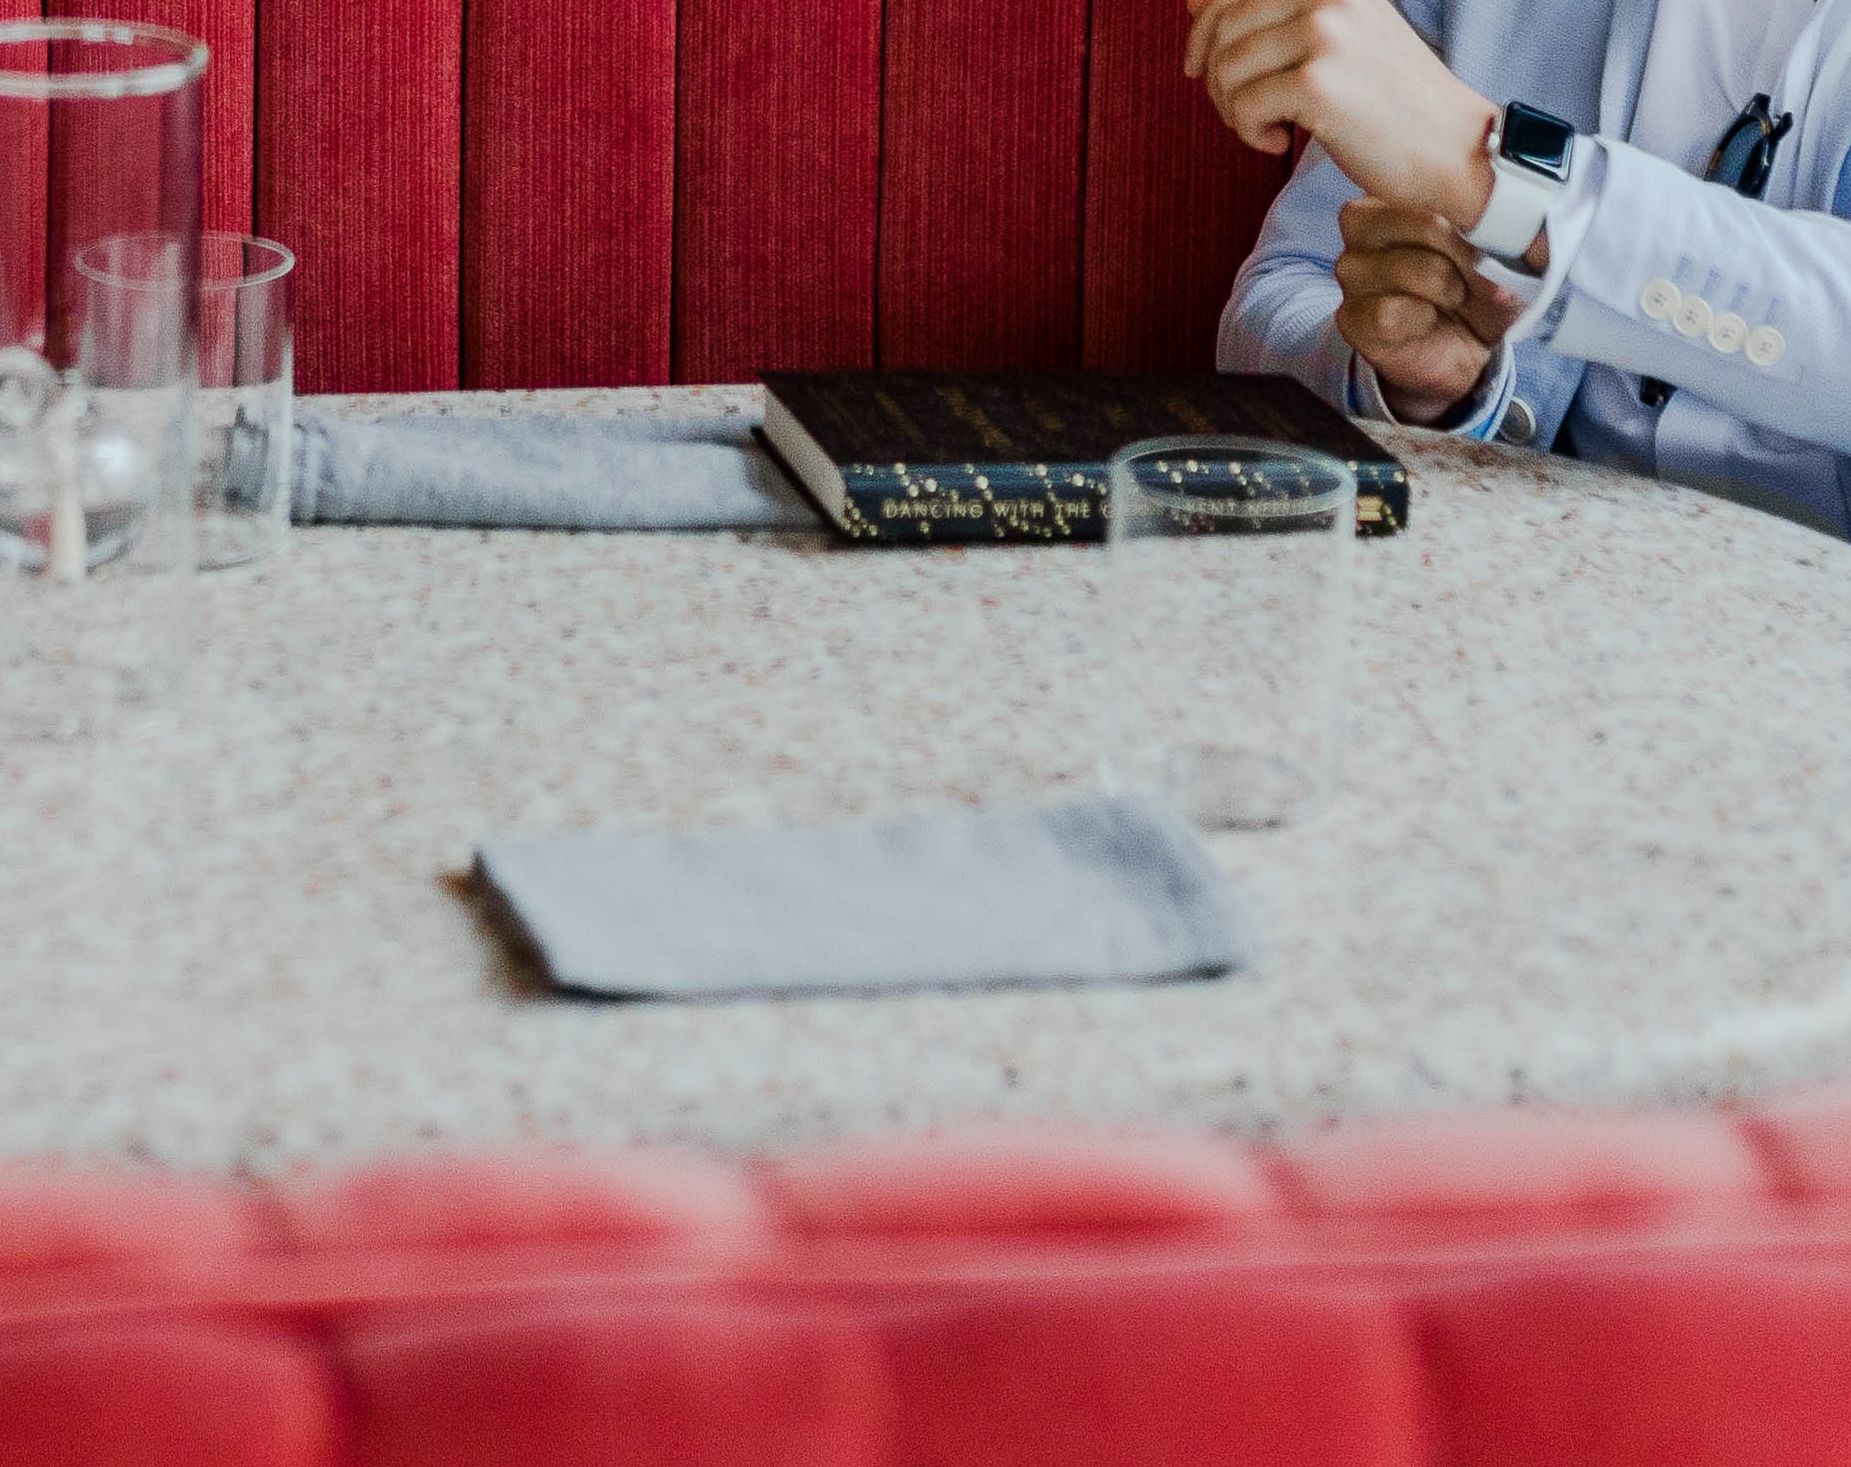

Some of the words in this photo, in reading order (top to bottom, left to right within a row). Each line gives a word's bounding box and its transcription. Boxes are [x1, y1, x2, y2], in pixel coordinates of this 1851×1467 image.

[881, 499, 984, 518] DANCING
[991, 498, 1045, 517] WITH
[1053, 498, 1092, 517] THE
